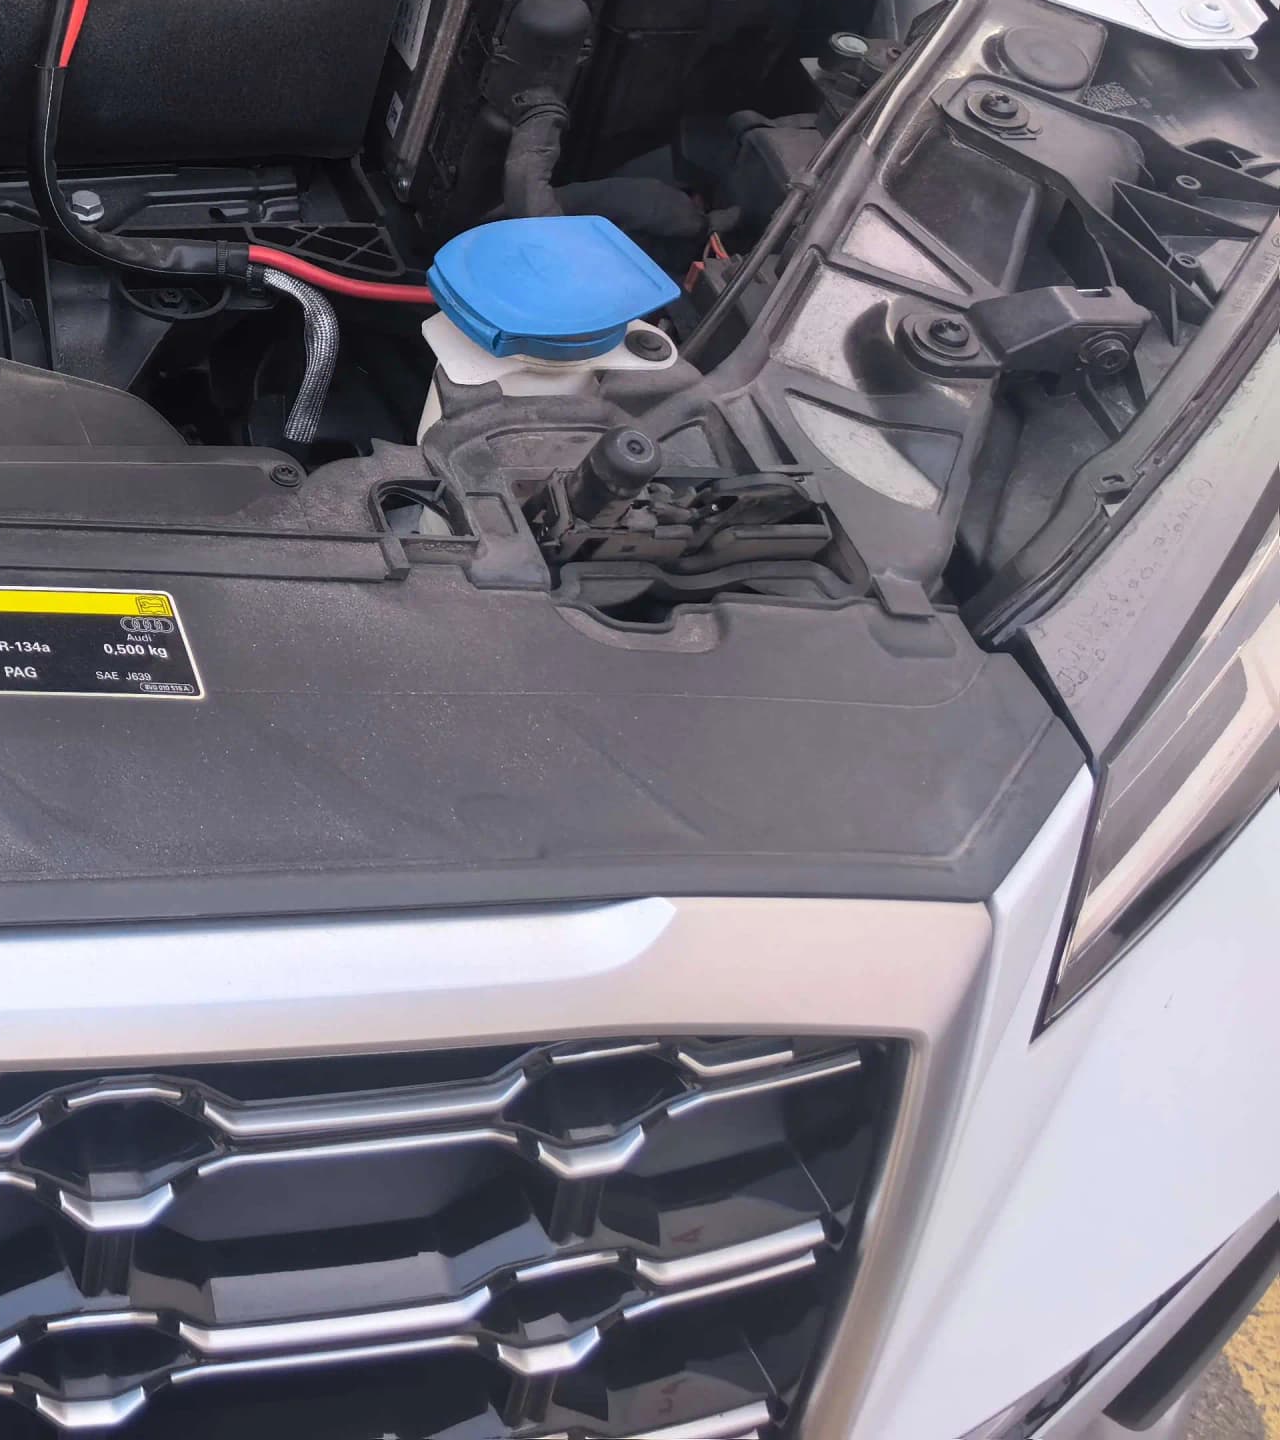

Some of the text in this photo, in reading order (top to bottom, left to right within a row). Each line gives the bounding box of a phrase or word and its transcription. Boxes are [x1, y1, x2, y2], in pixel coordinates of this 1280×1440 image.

[126, 633, 153, 642] Audi
[103, 643, 145, 657] 0,500
[148, 644, 168, 658] kg
[4, 665, 152, 681] PAG SAE J639
